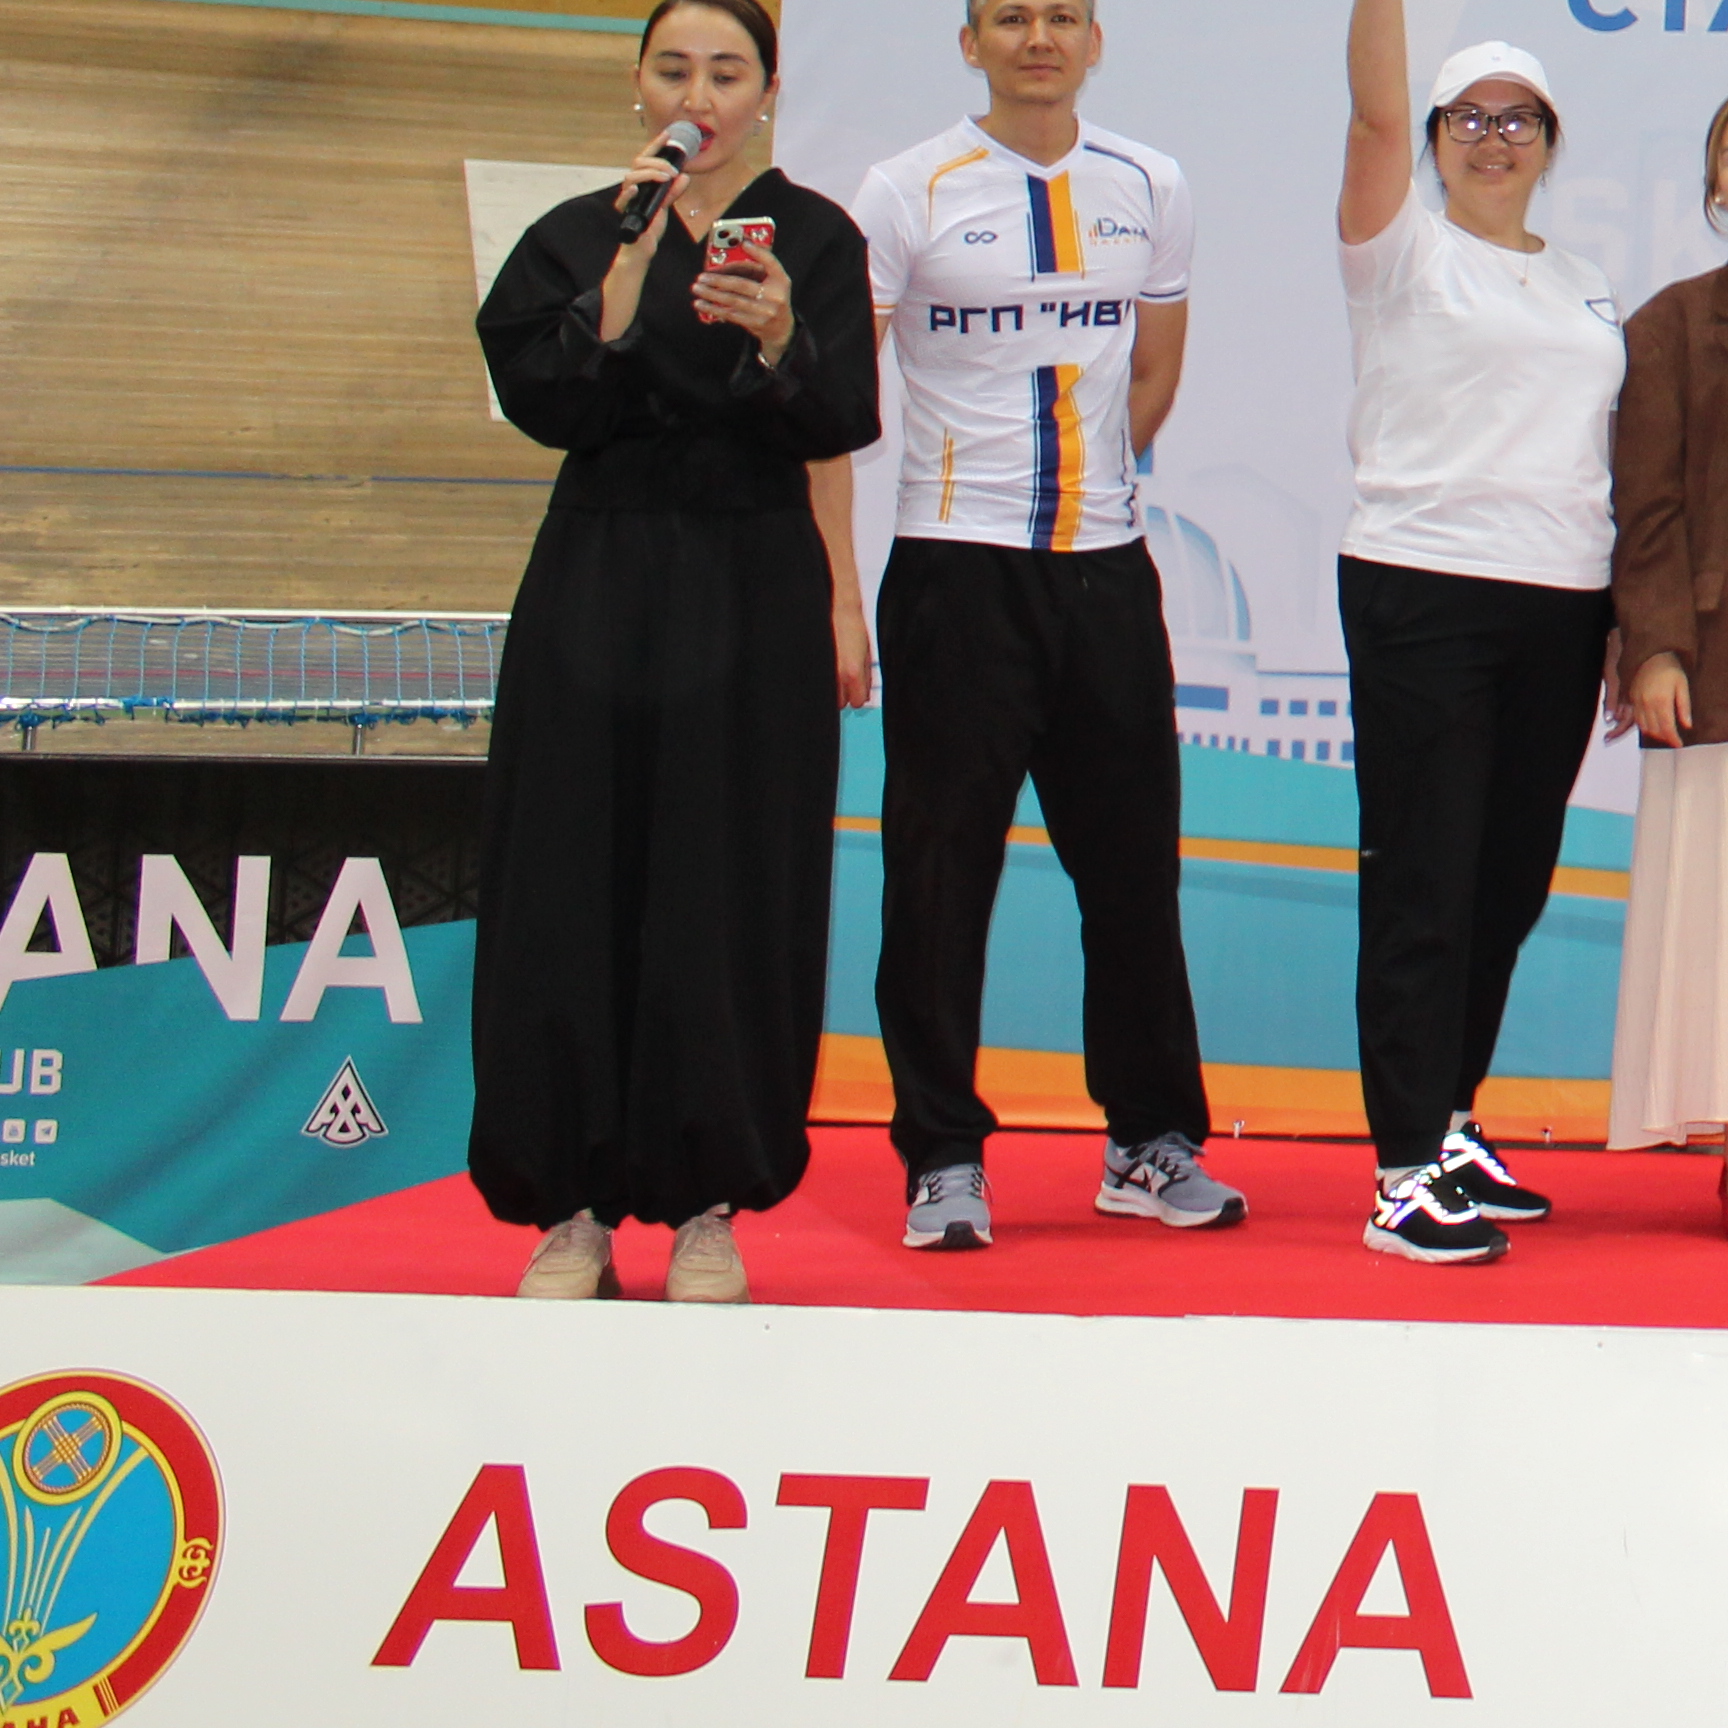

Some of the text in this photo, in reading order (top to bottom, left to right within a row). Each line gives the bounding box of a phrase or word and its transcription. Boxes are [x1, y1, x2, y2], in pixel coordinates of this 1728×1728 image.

[930, 297, 1132, 334] РГП "ИВ
[371, 1463, 1474, 1700] ASTANA
